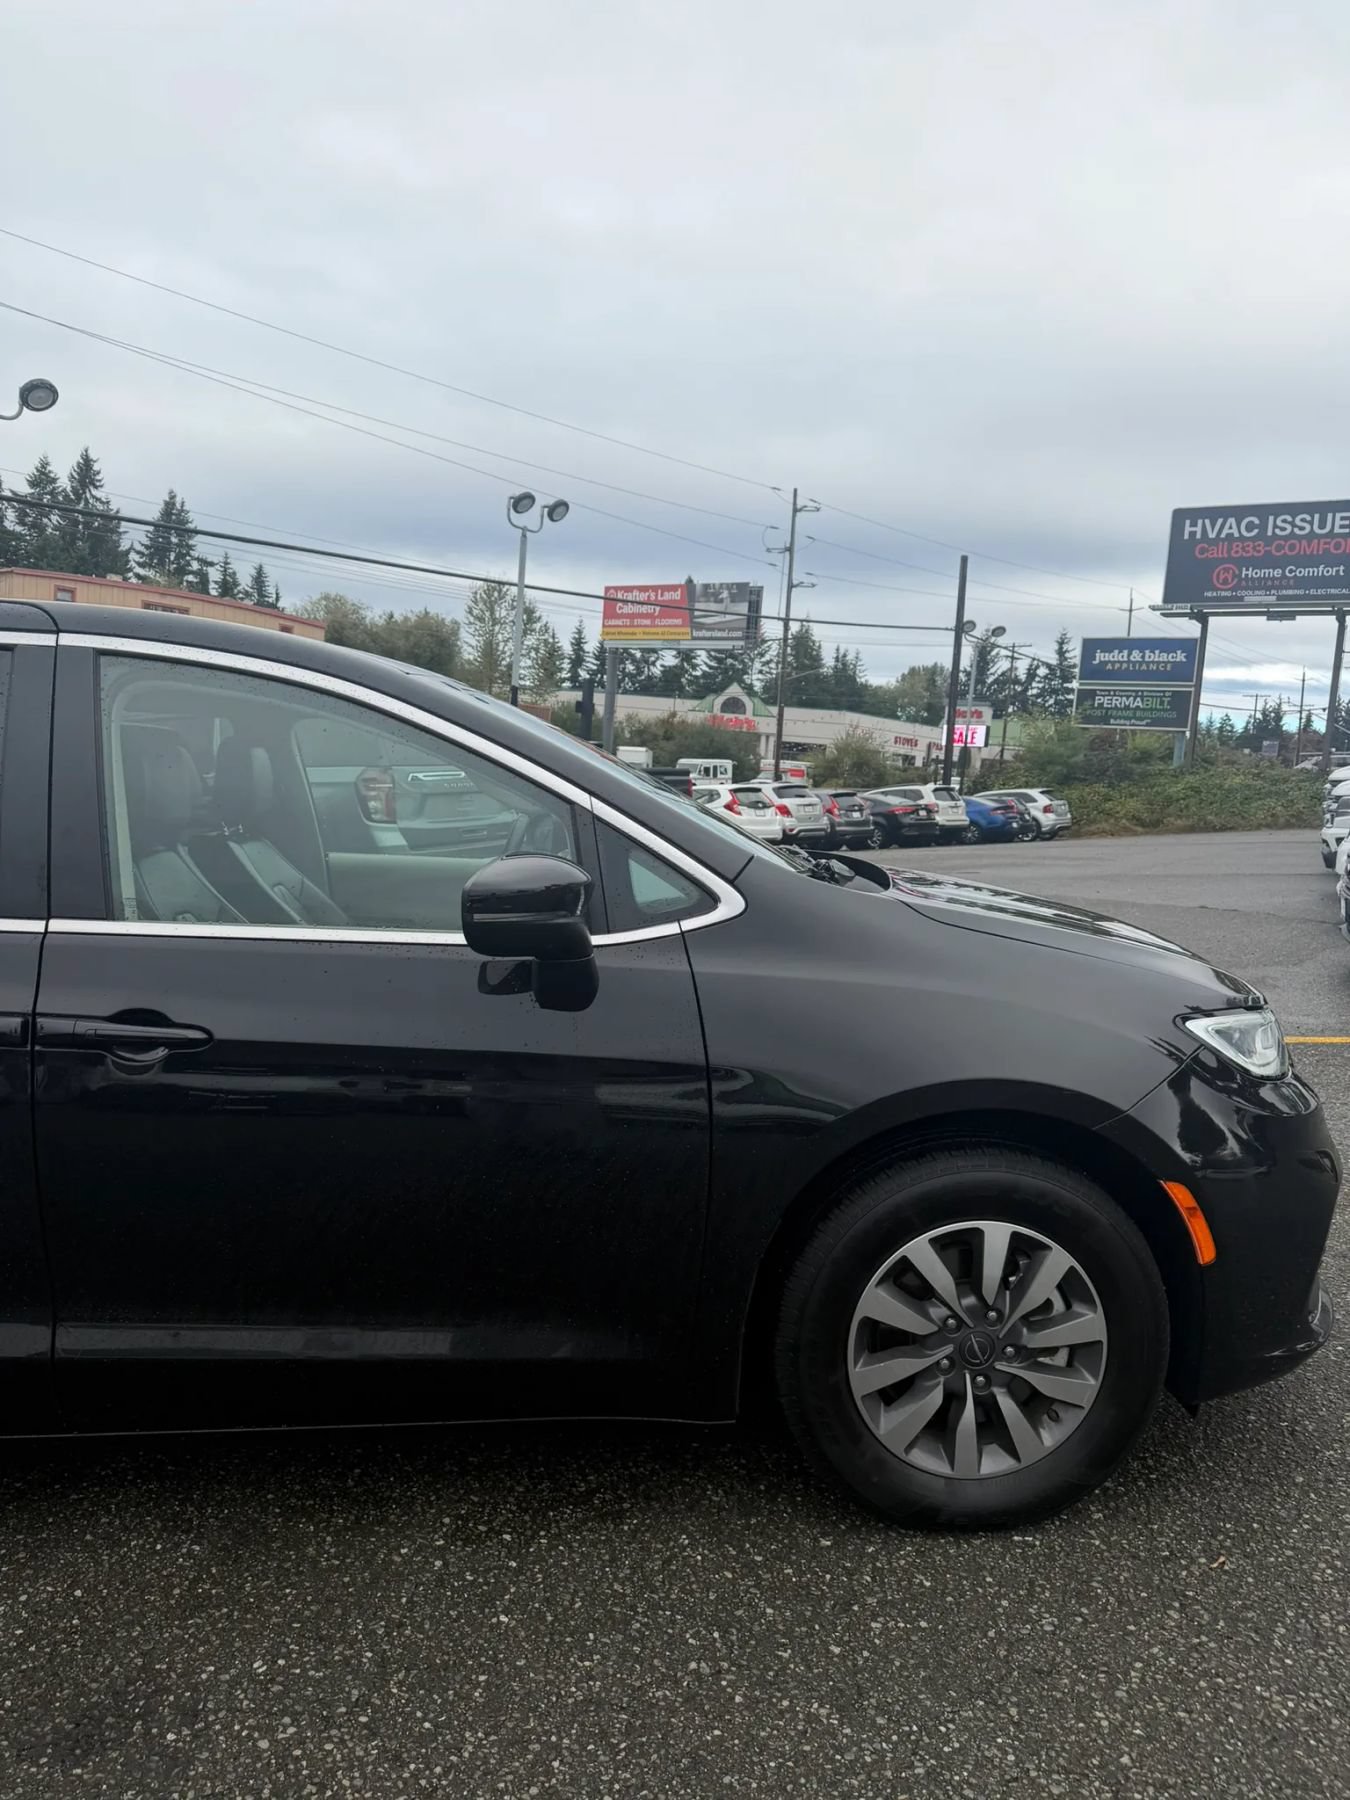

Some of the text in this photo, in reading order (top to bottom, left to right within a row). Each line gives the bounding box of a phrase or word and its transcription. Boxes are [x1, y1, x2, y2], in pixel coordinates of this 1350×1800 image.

[1184, 512, 1350, 540] HVAC ISSUE
[1195, 542, 1228, 559] Call
[1242, 564, 1345, 578] Home Comfort
[1241, 579, 1295, 587] ALLIANCE
[617, 588, 681, 601] Krafter's Land
[616, 603, 660, 616] Cabinetry
[1092, 649, 1187, 664] judd & black
[894, 736, 918, 747] STOVES
[952, 731, 976, 744] SAE
